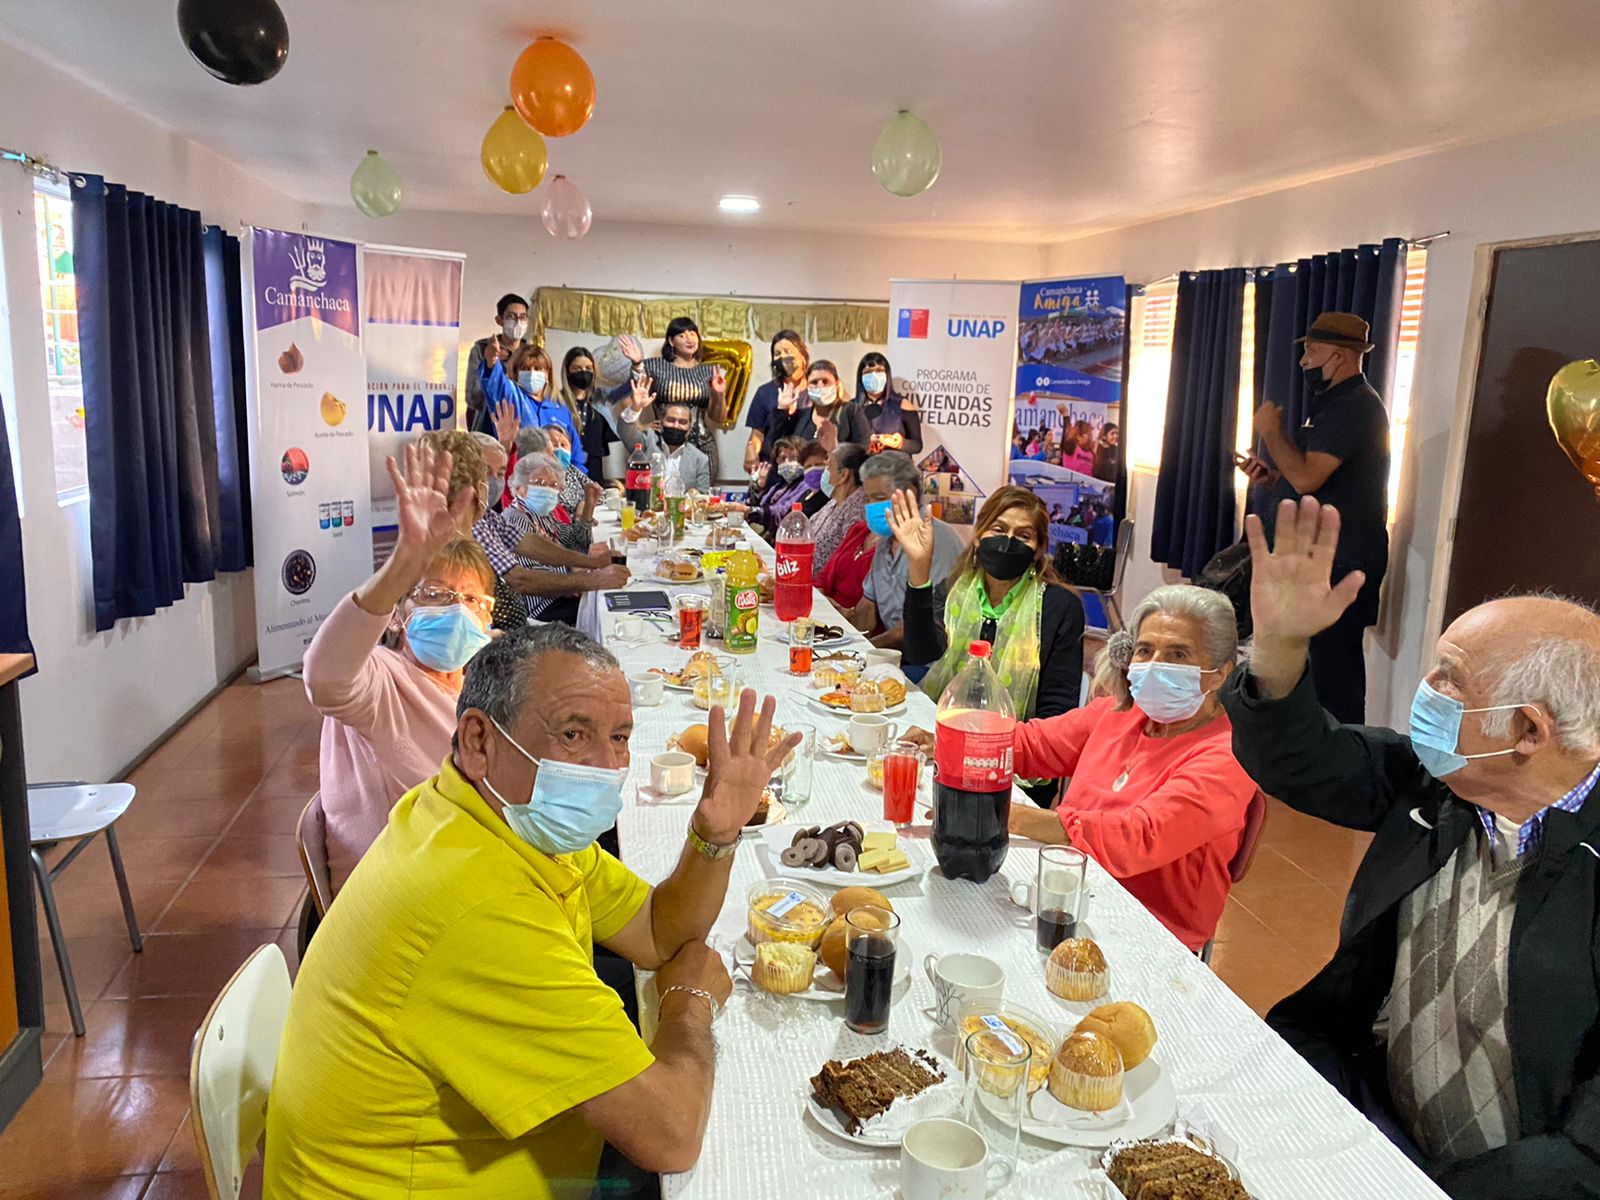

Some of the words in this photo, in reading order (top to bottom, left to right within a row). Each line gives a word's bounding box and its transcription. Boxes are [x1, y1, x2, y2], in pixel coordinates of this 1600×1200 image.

[265, 286, 350, 311] Camanchaca
[1034, 293, 1081, 316] Amiga
[948, 318, 1005, 338] UNAP
[916, 369, 977, 382] PROGRAMA
[901, 380, 973, 394] CONDOMINIO
[976, 383, 991, 395] DE
[777, 559, 800, 577] Bilz
